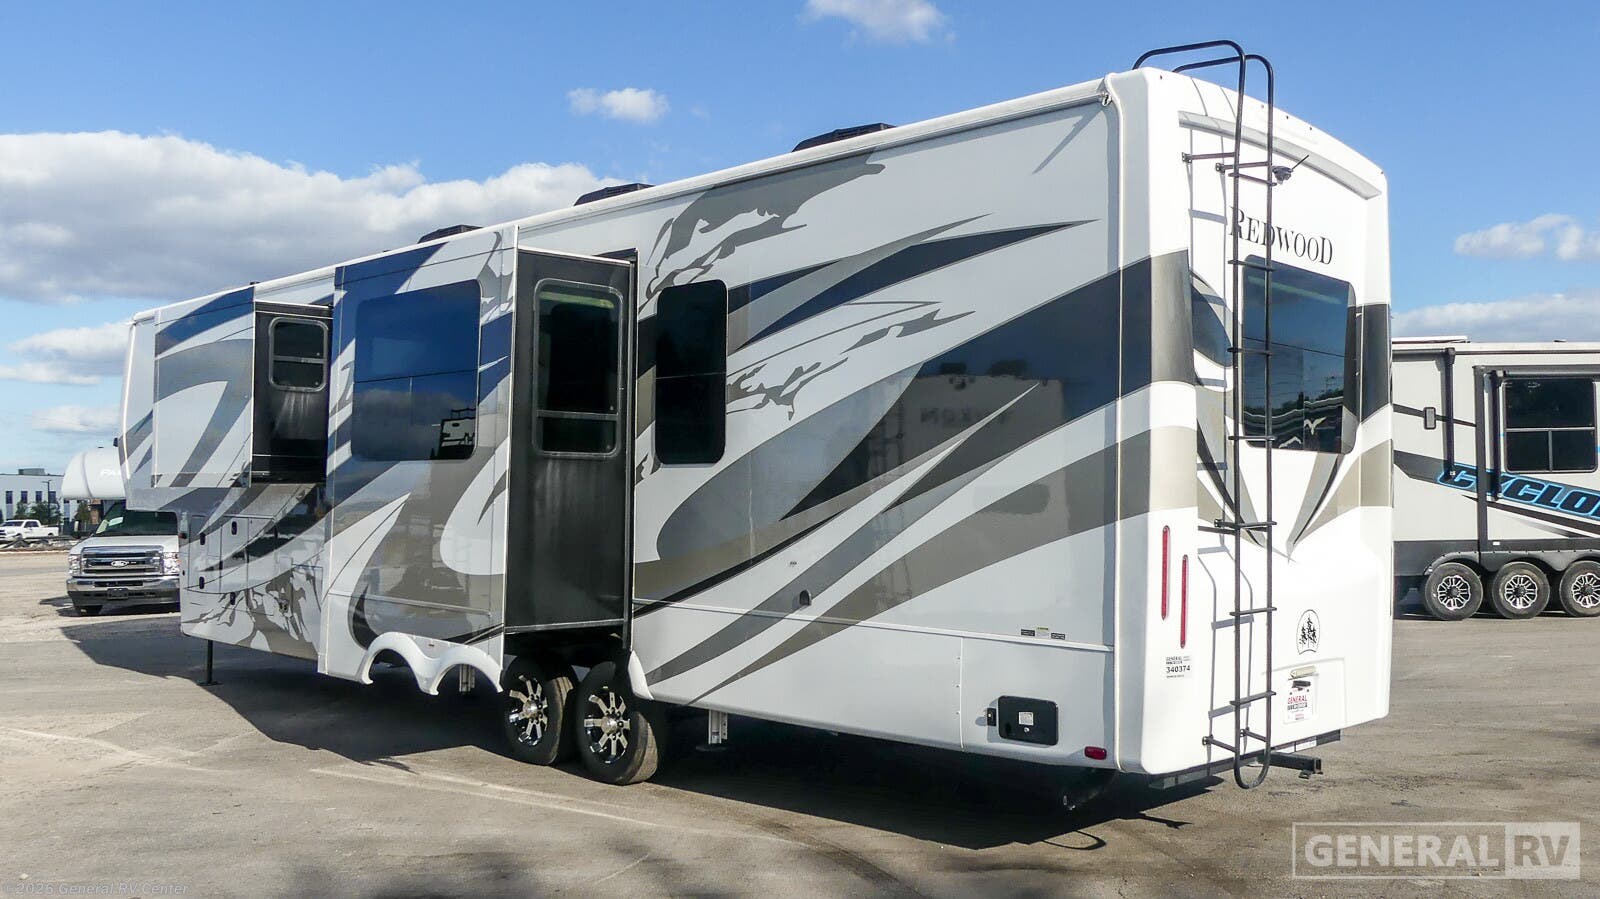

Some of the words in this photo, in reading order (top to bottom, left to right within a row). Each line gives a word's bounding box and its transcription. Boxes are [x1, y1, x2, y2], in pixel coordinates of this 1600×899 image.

[1227, 206, 1334, 265] REDWOOD
[1438, 462, 1600, 519] CCLO
[1166, 665, 1191, 673] 340374
